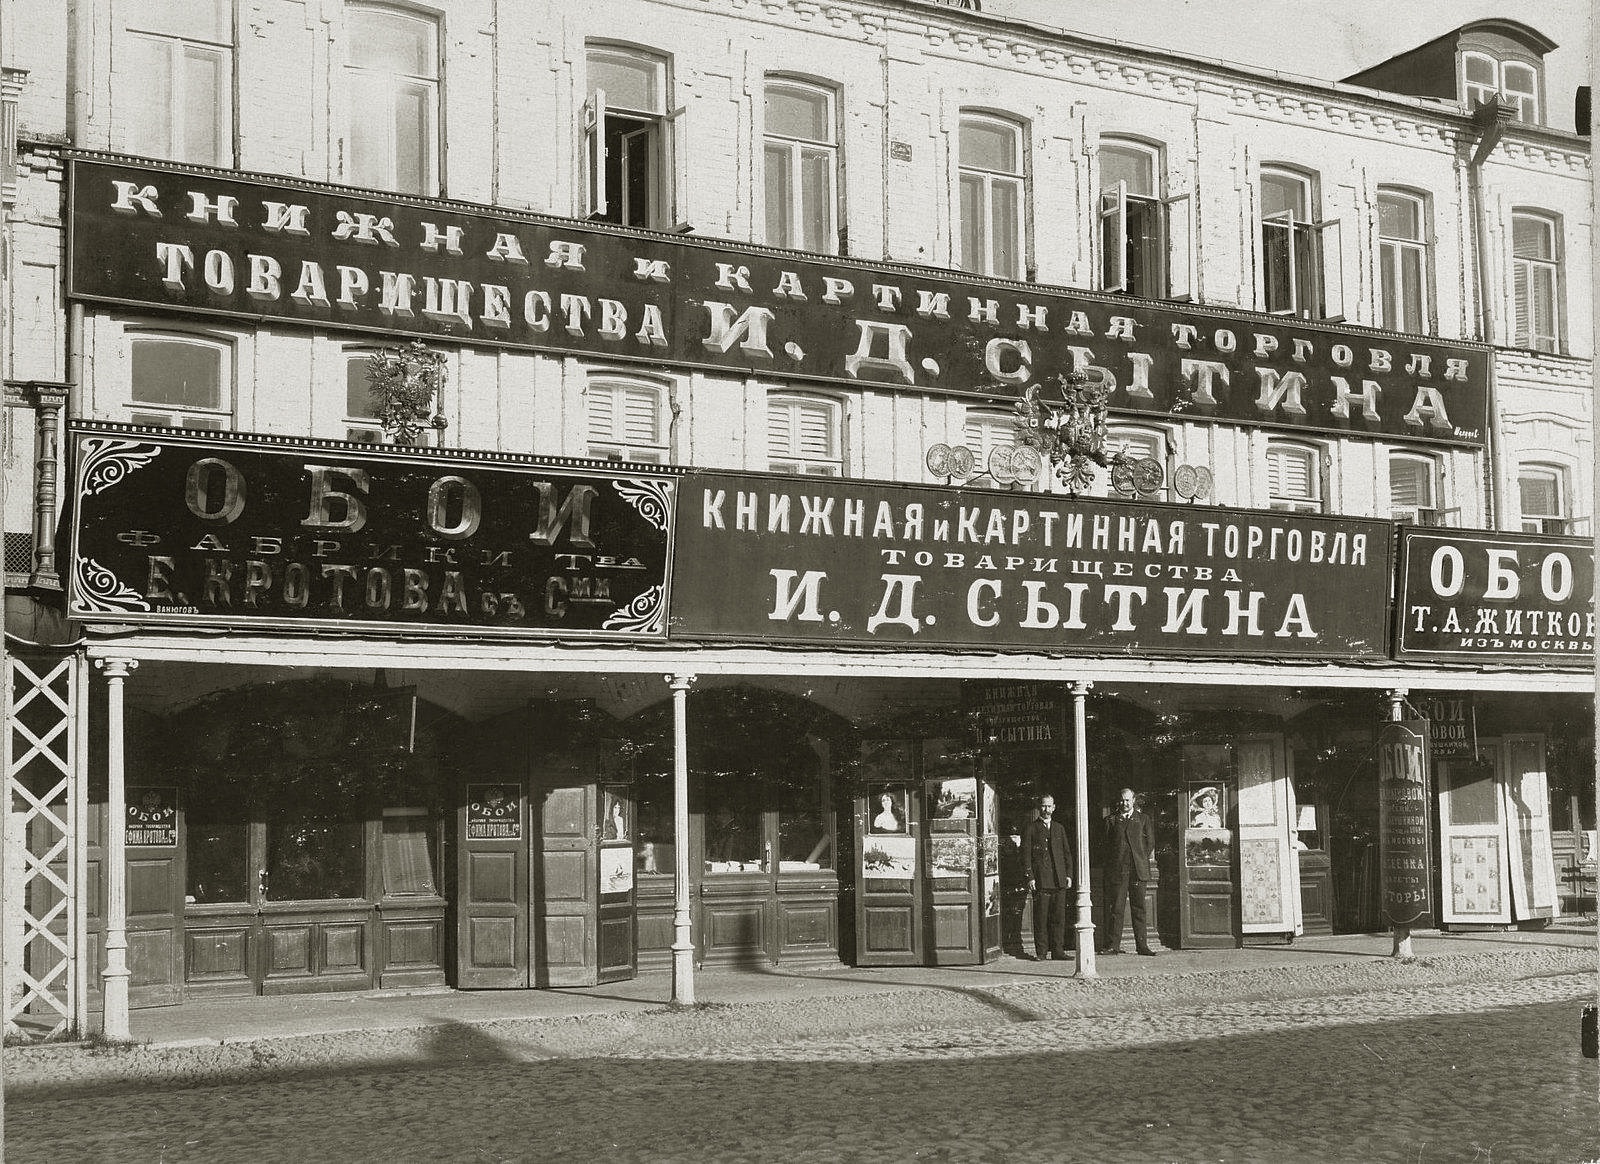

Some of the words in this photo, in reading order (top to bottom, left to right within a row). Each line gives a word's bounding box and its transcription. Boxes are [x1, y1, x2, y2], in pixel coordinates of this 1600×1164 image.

[111, 180, 586, 271] КНИЖНАЯ
[715, 262, 1137, 342] КАРТИННАЯ
[1172, 323, 1469, 381] ТОРГОВЛЯ
[156, 242, 669, 347] ТОВАРИЩЕСТВА
[702, 301, 805, 361] И.
[845, 319, 940, 384] Д.
[985, 337, 1453, 429] СЫТИНА
[185, 457, 599, 549] ОБОИ
[703, 488, 923, 541] КНИЖНАЯ
[957, 506, 1184, 555] КАРТИННАЯ
[1201, 523, 1367, 566] ТОРГОВЛЯ
[117, 530, 513, 567] ФАБРИКИ
[881, 549, 1242, 582] ТОВАРИЩЕСТВА
[1431, 545, 1595, 604] ОБО
[202, 557, 468, 616] КРОТОВА
[768, 568, 840, 622] И.
[867, 574, 936, 636] Д.
[967, 579, 1318, 638] СЫТИНА
[129, 806, 174, 821] ОБОИ
[471, 801, 517, 816] ОБОИ
[1383, 888, 1426, 904] ТОРЫ
